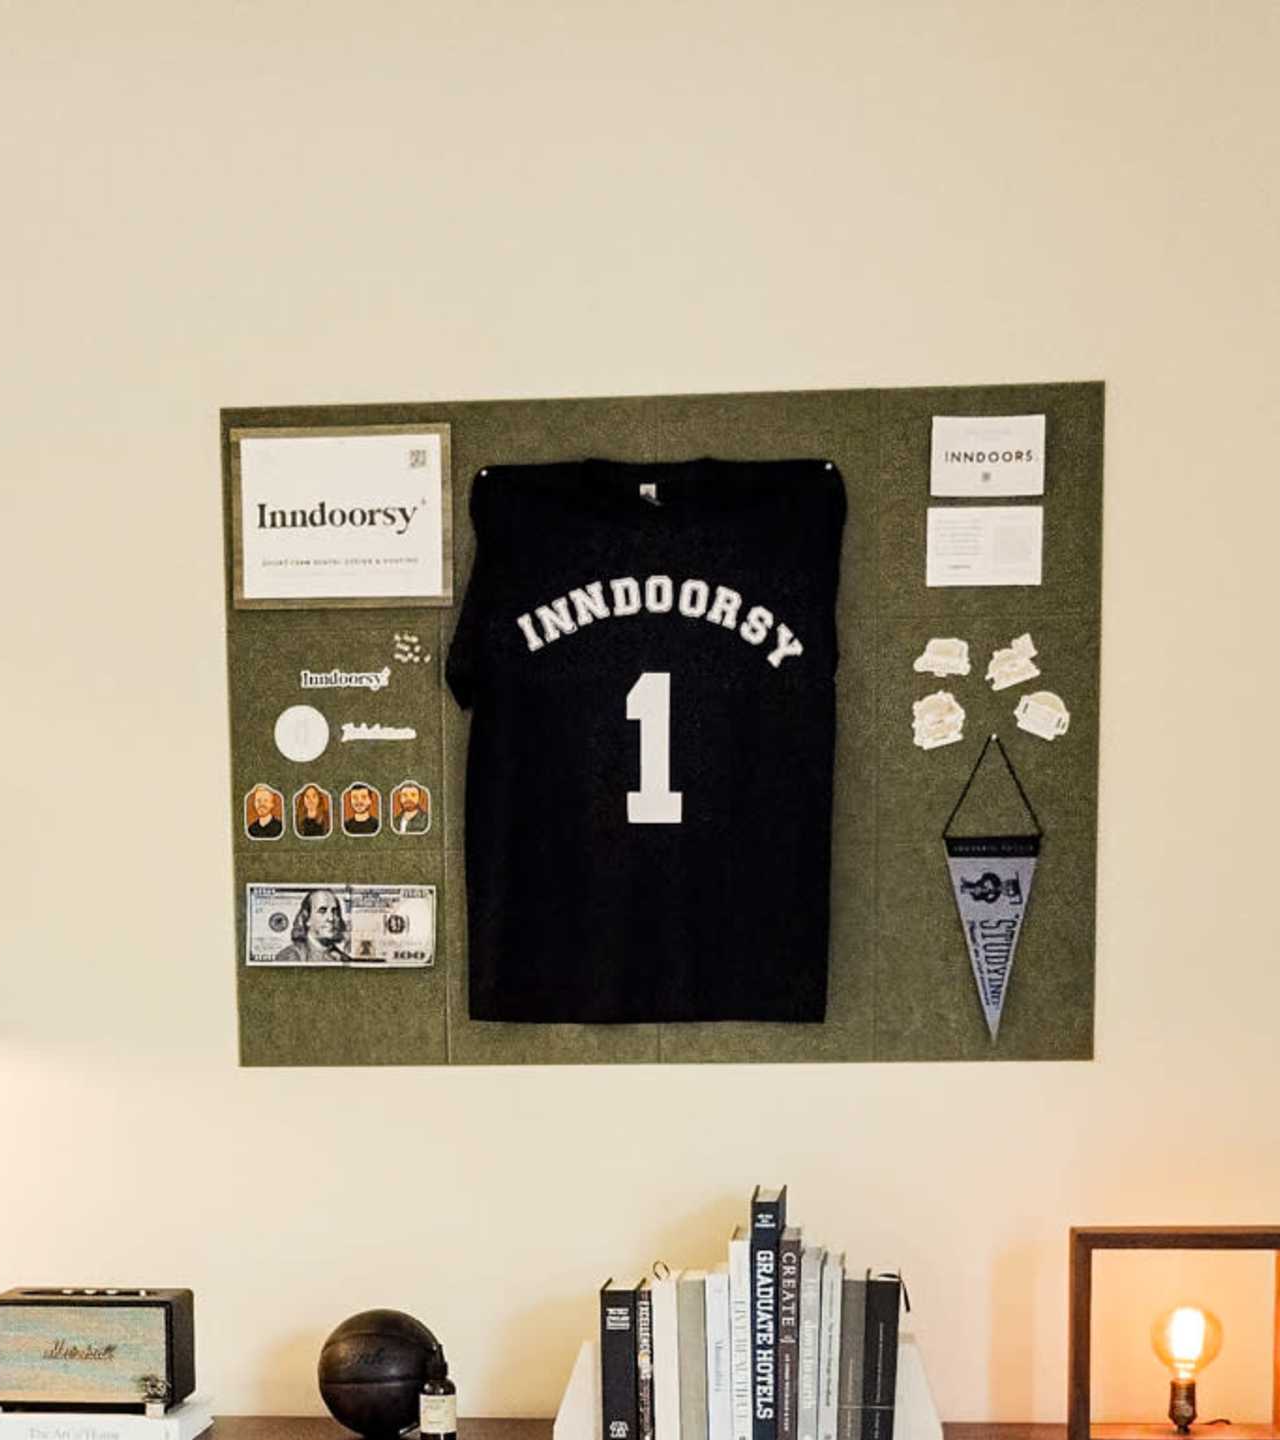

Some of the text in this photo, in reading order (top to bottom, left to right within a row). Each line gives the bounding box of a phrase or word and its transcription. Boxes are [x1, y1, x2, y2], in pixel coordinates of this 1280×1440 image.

[257, 501, 418, 535] Inndoorsy
[516, 574, 804, 668] INNDOORSY
[303, 671, 382, 689] Inndoorsy
[626, 672, 682, 824] 1
[781, 1251, 796, 1326] CREATE
[756, 1250, 774, 1420] GRADUATE HOTELS
